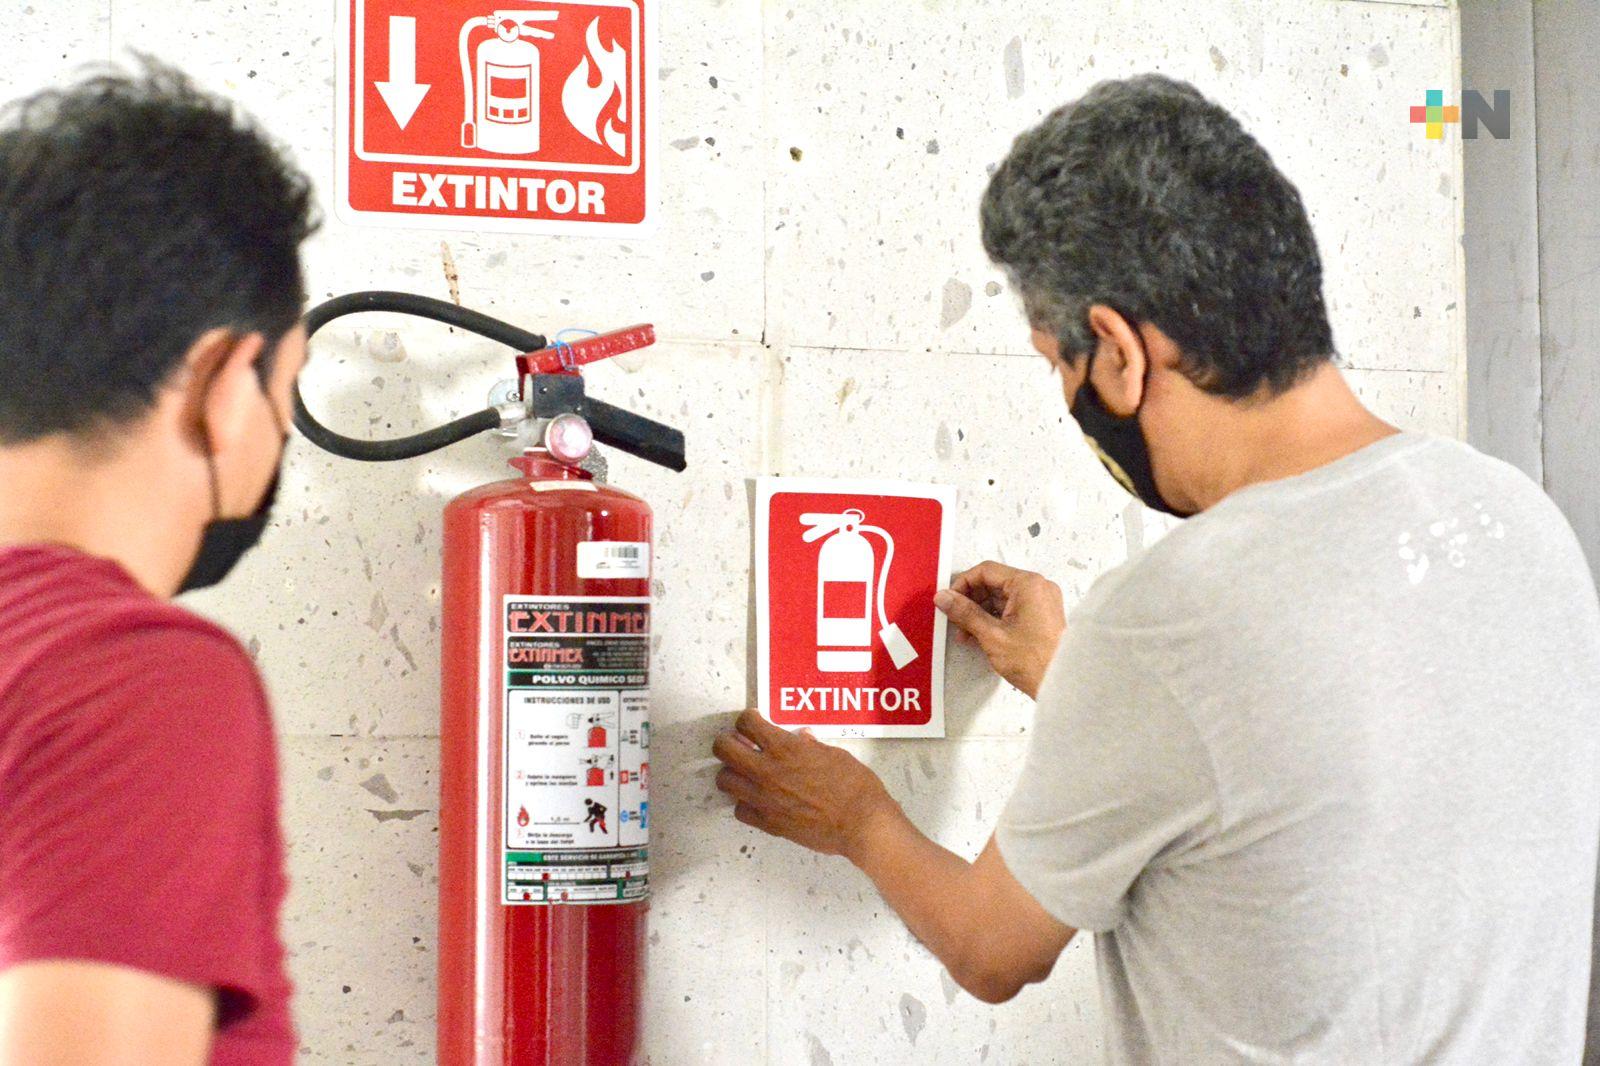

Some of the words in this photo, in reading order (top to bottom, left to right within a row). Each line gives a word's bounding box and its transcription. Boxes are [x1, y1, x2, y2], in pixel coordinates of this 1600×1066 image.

[392, 171, 606, 215] EXTINTOR
[532, 675, 576, 684] POLVO
[578, 675, 625, 686] QUIMICO
[780, 687, 921, 712] EXTINTOR
